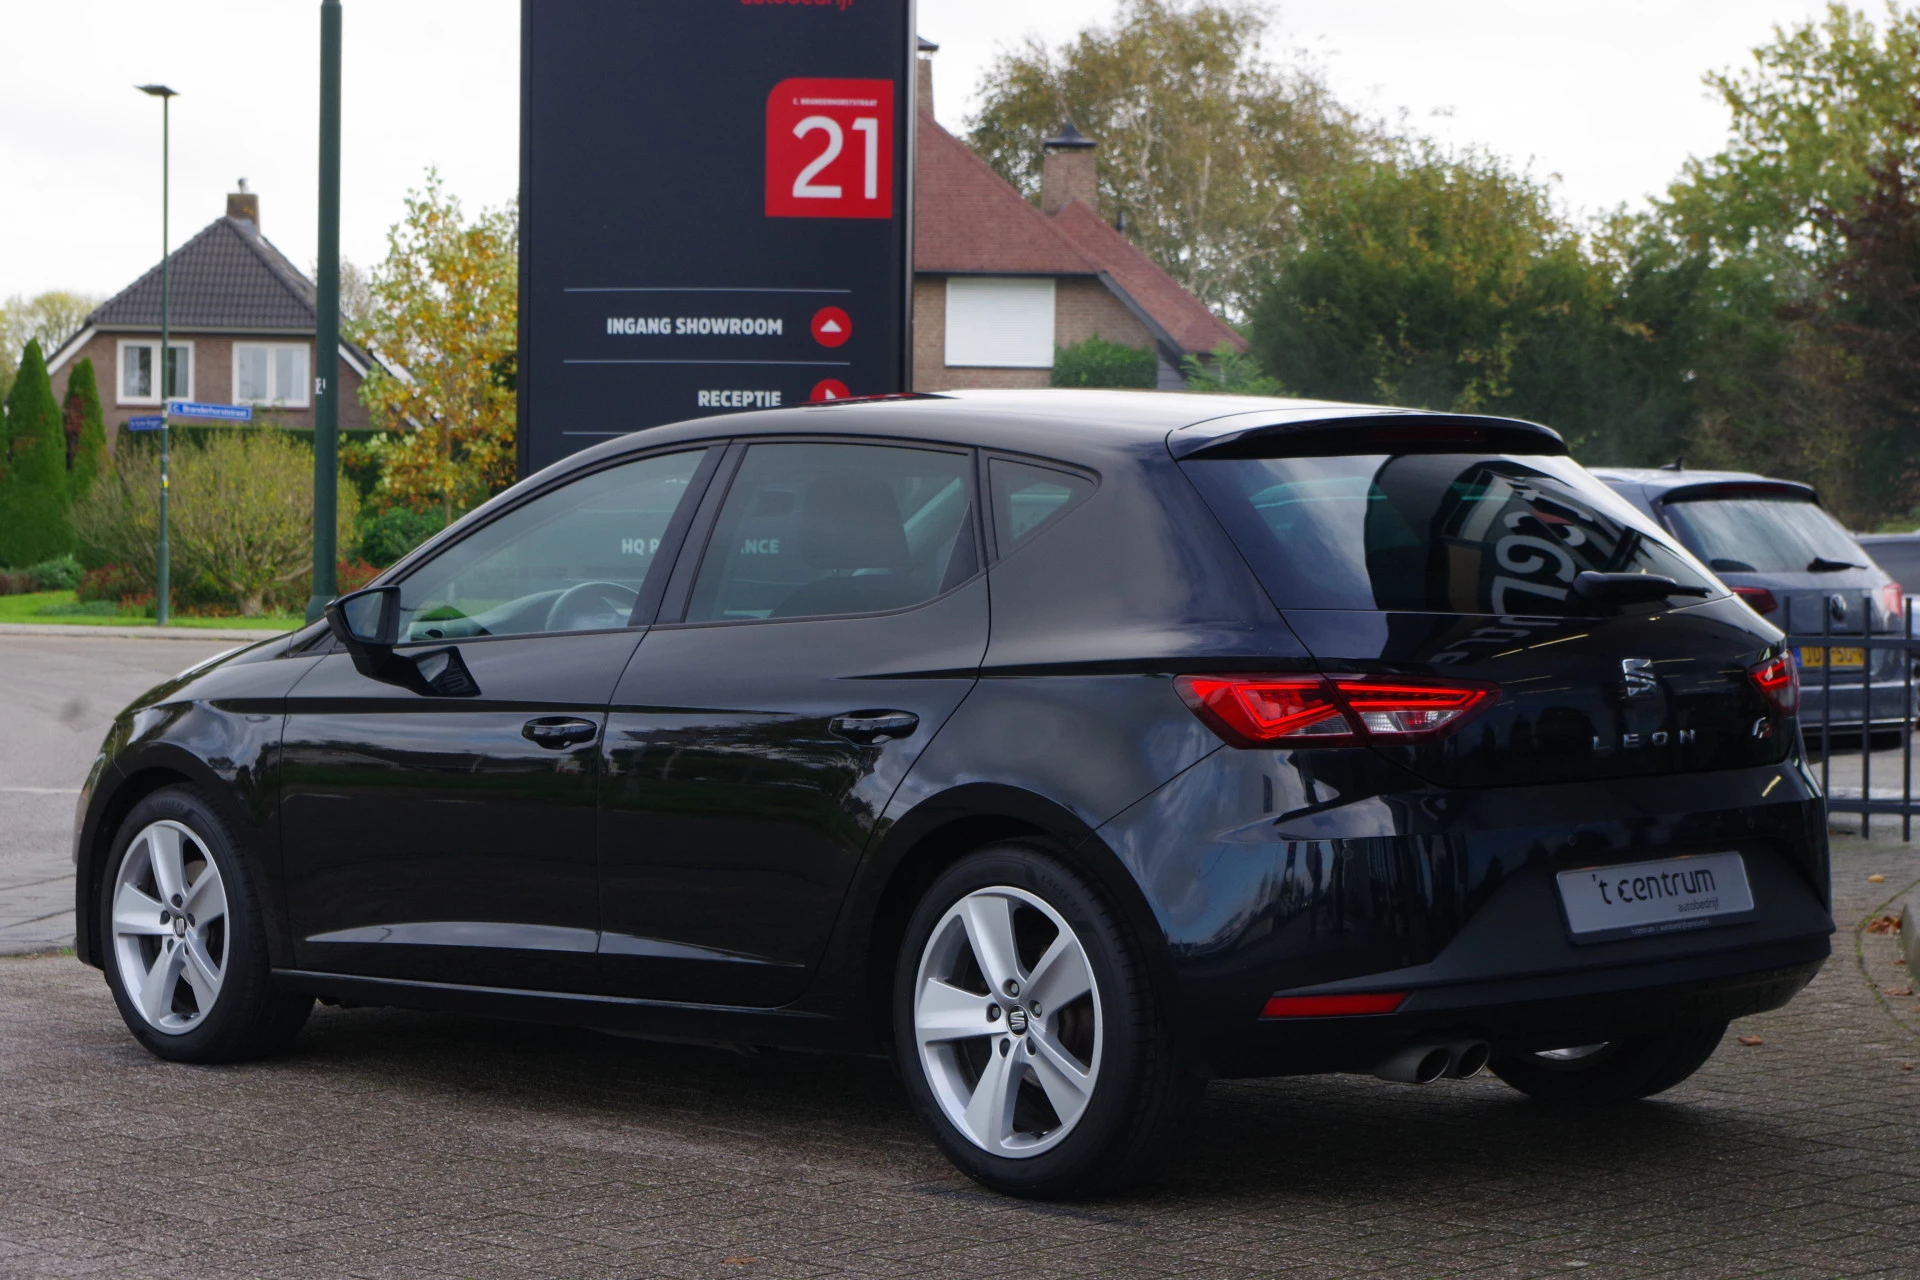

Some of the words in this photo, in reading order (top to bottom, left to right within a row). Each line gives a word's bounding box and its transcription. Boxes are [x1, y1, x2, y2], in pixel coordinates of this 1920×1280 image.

[792, 115, 878, 200] 21
[607, 317, 672, 335] INGANG
[675, 317, 783, 336] SHOWROOM
[698, 390, 782, 408] RECEPTIE
[621, 538, 646, 556] HQ
[1593, 729, 1696, 750] LEON
[1618, 869, 1716, 903] centrum
